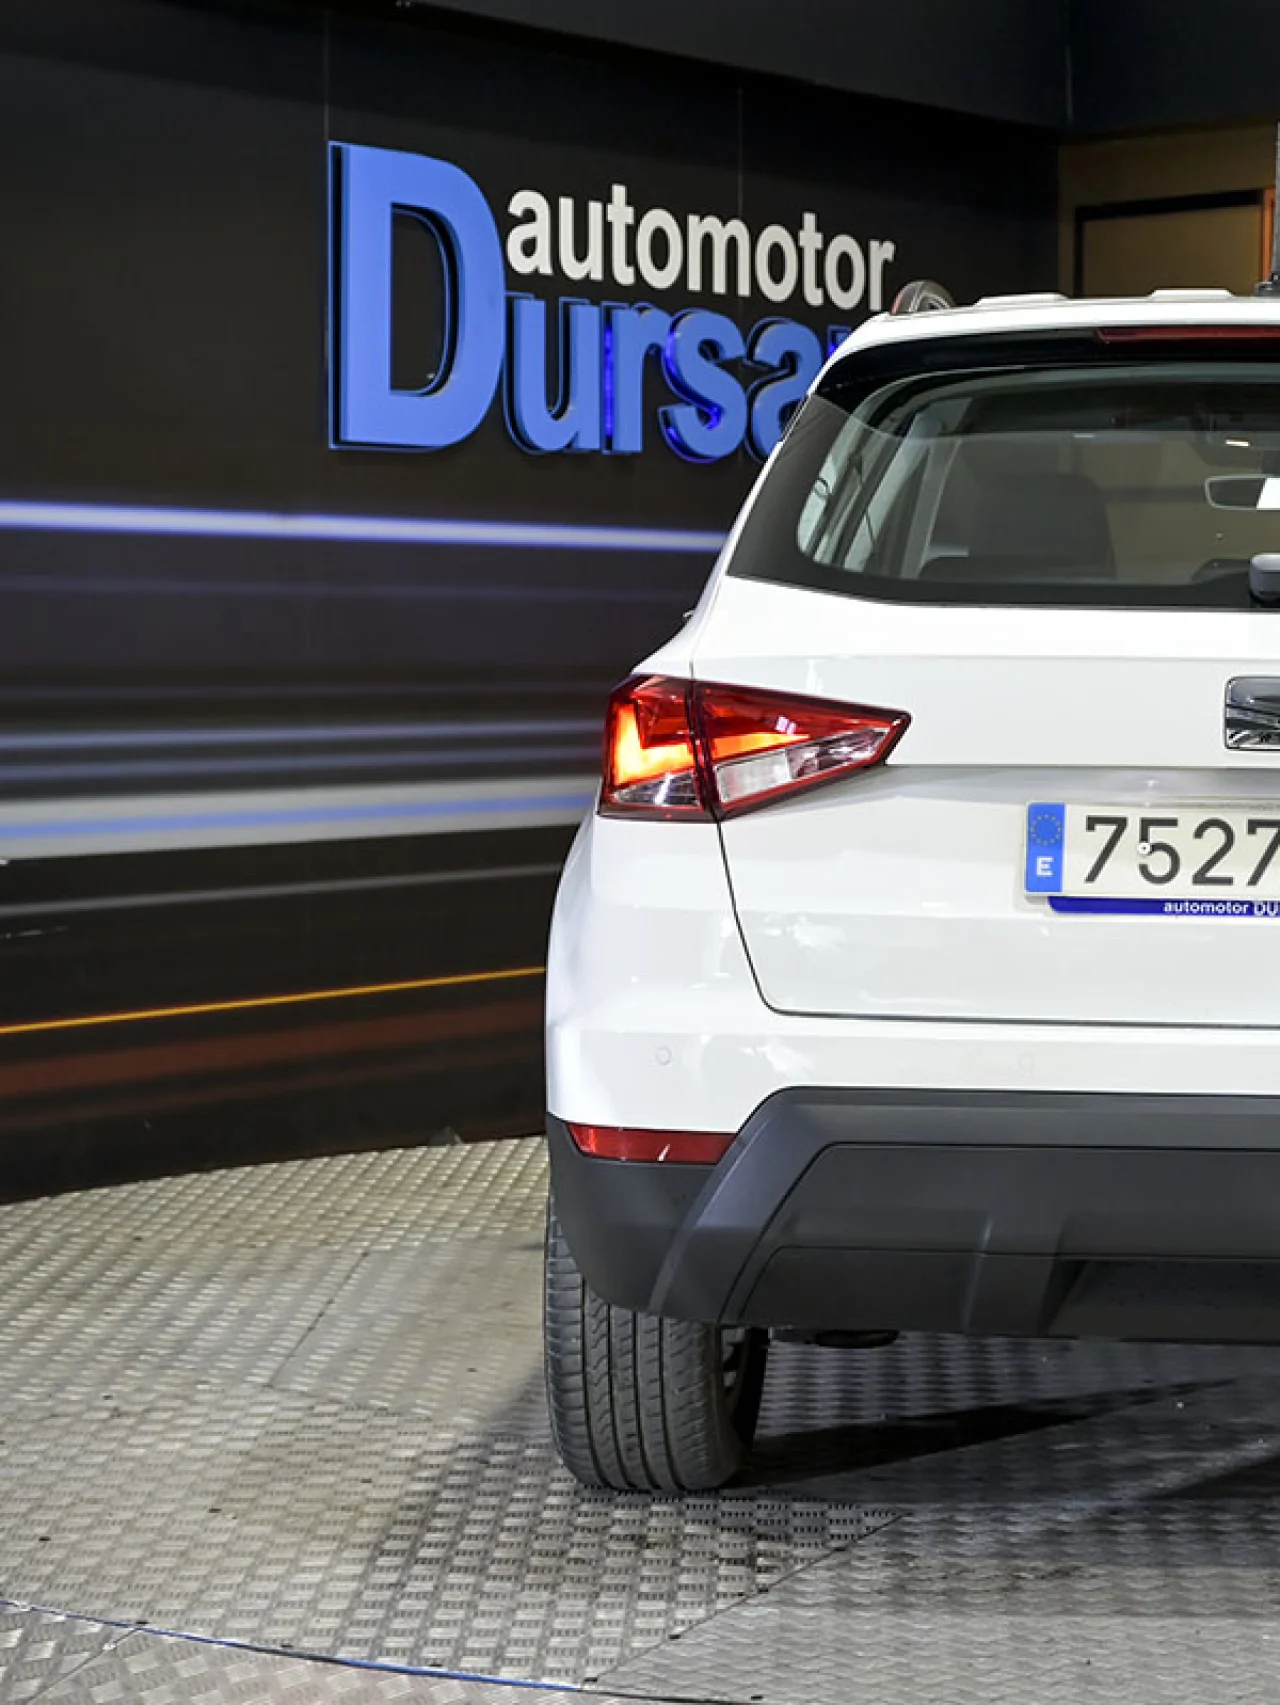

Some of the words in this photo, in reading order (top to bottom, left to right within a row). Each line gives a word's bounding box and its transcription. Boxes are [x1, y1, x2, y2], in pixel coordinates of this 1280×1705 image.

[507, 183, 895, 312] automotor
[328, 140, 852, 463] Dursa
[1036, 856, 1054, 877] E
[1164, 900, 1249, 915] automotor
